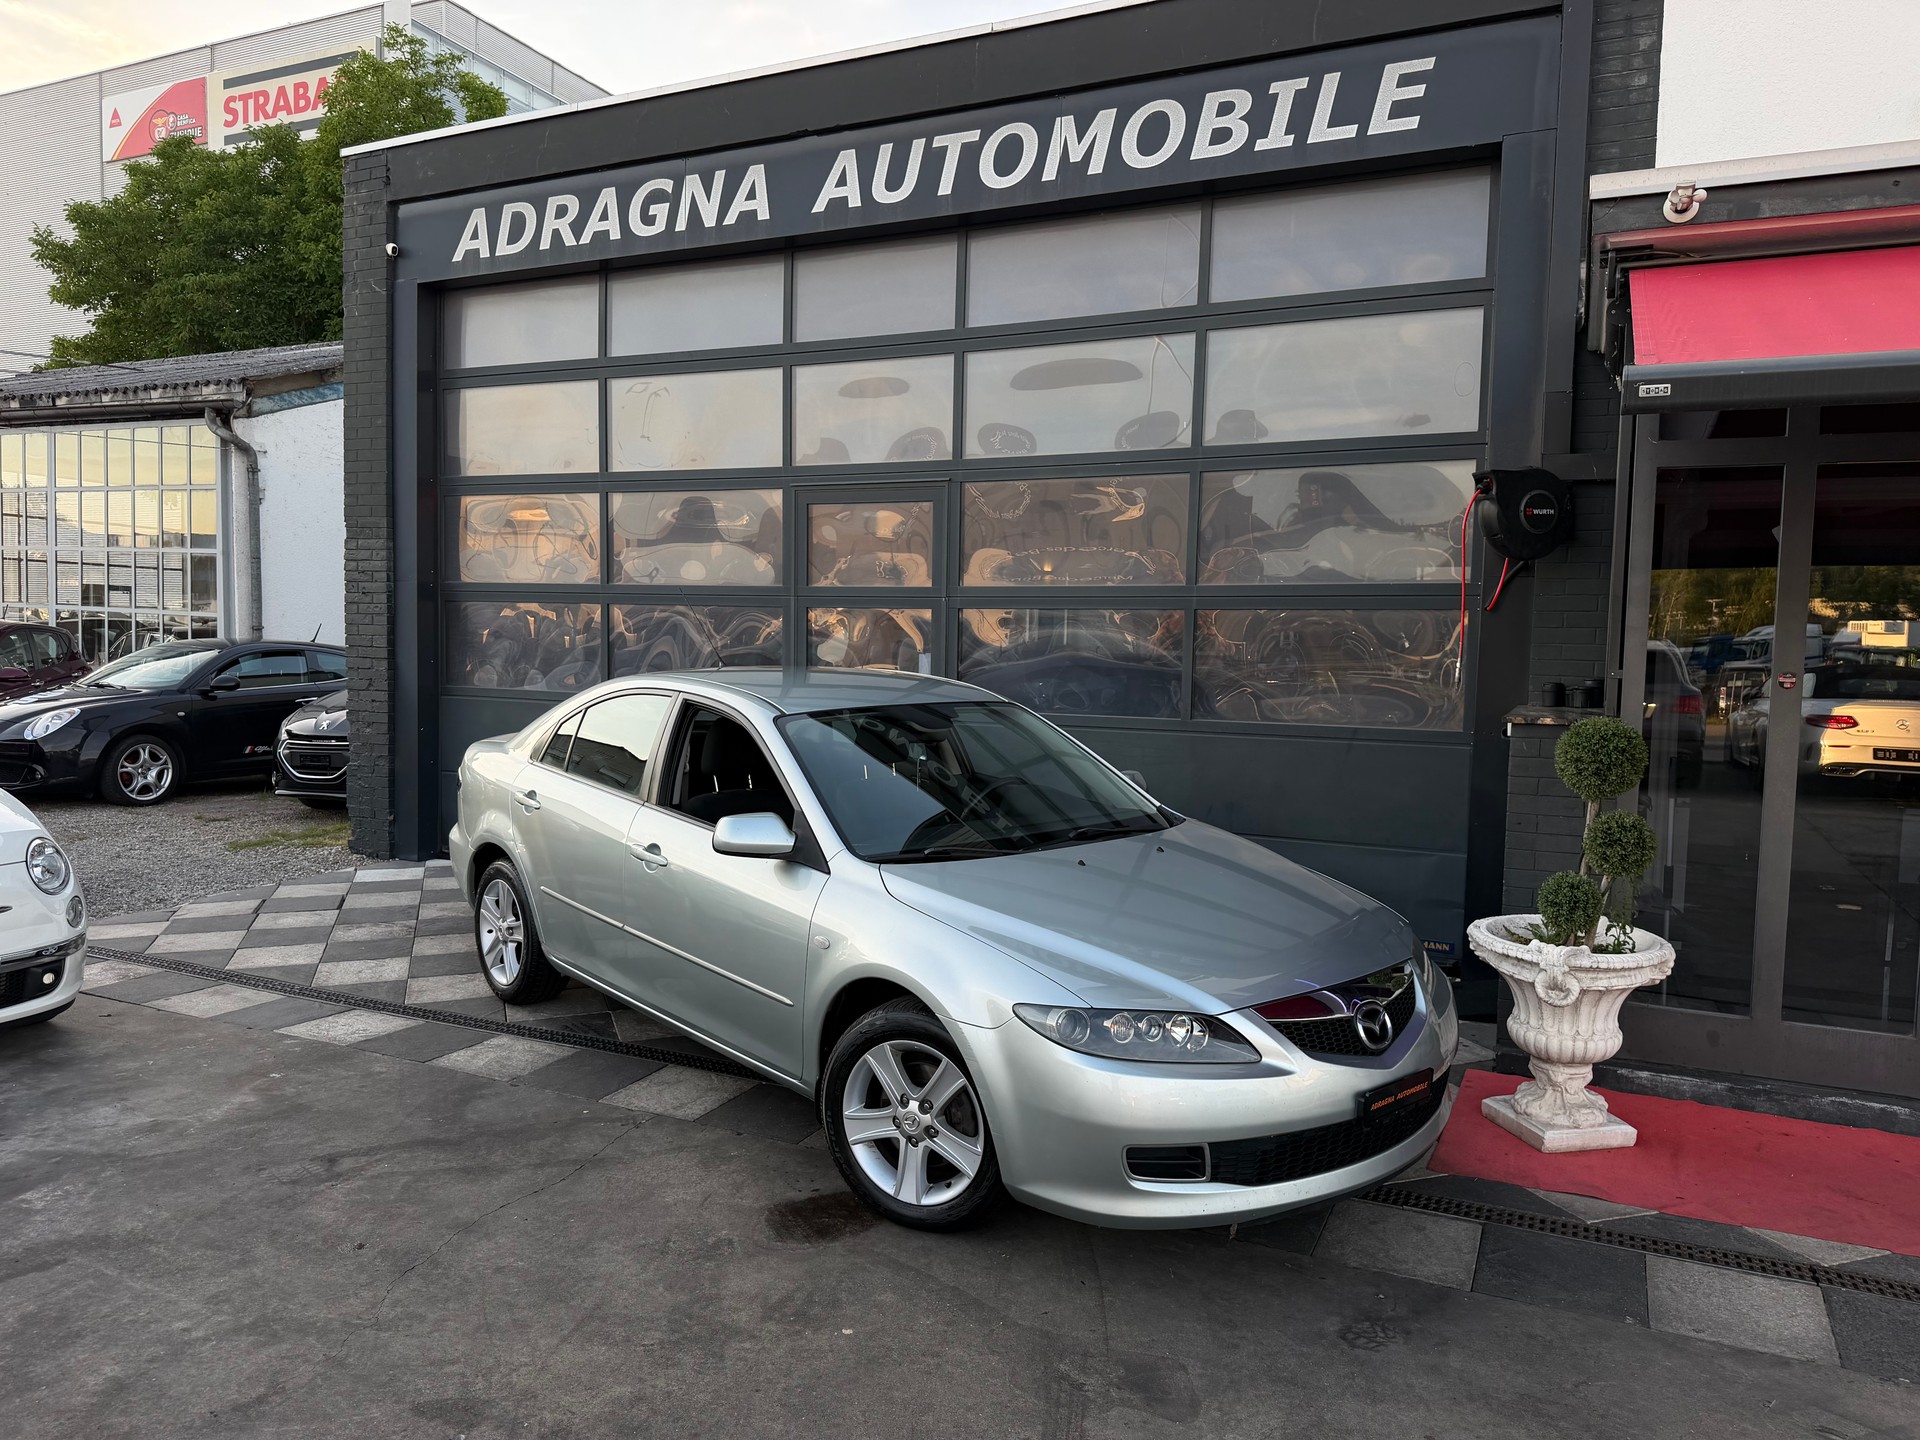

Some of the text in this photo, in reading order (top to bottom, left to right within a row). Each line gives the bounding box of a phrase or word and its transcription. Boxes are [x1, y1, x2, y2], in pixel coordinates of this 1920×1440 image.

[176, 113, 189, 121] CASA
[223, 76, 344, 129] STRABA
[451, 56, 1436, 262] ADRAGNA AUTOMOBILE
[1370, 1081, 1429, 1111] ADRAGNA AUTOMOBILE
